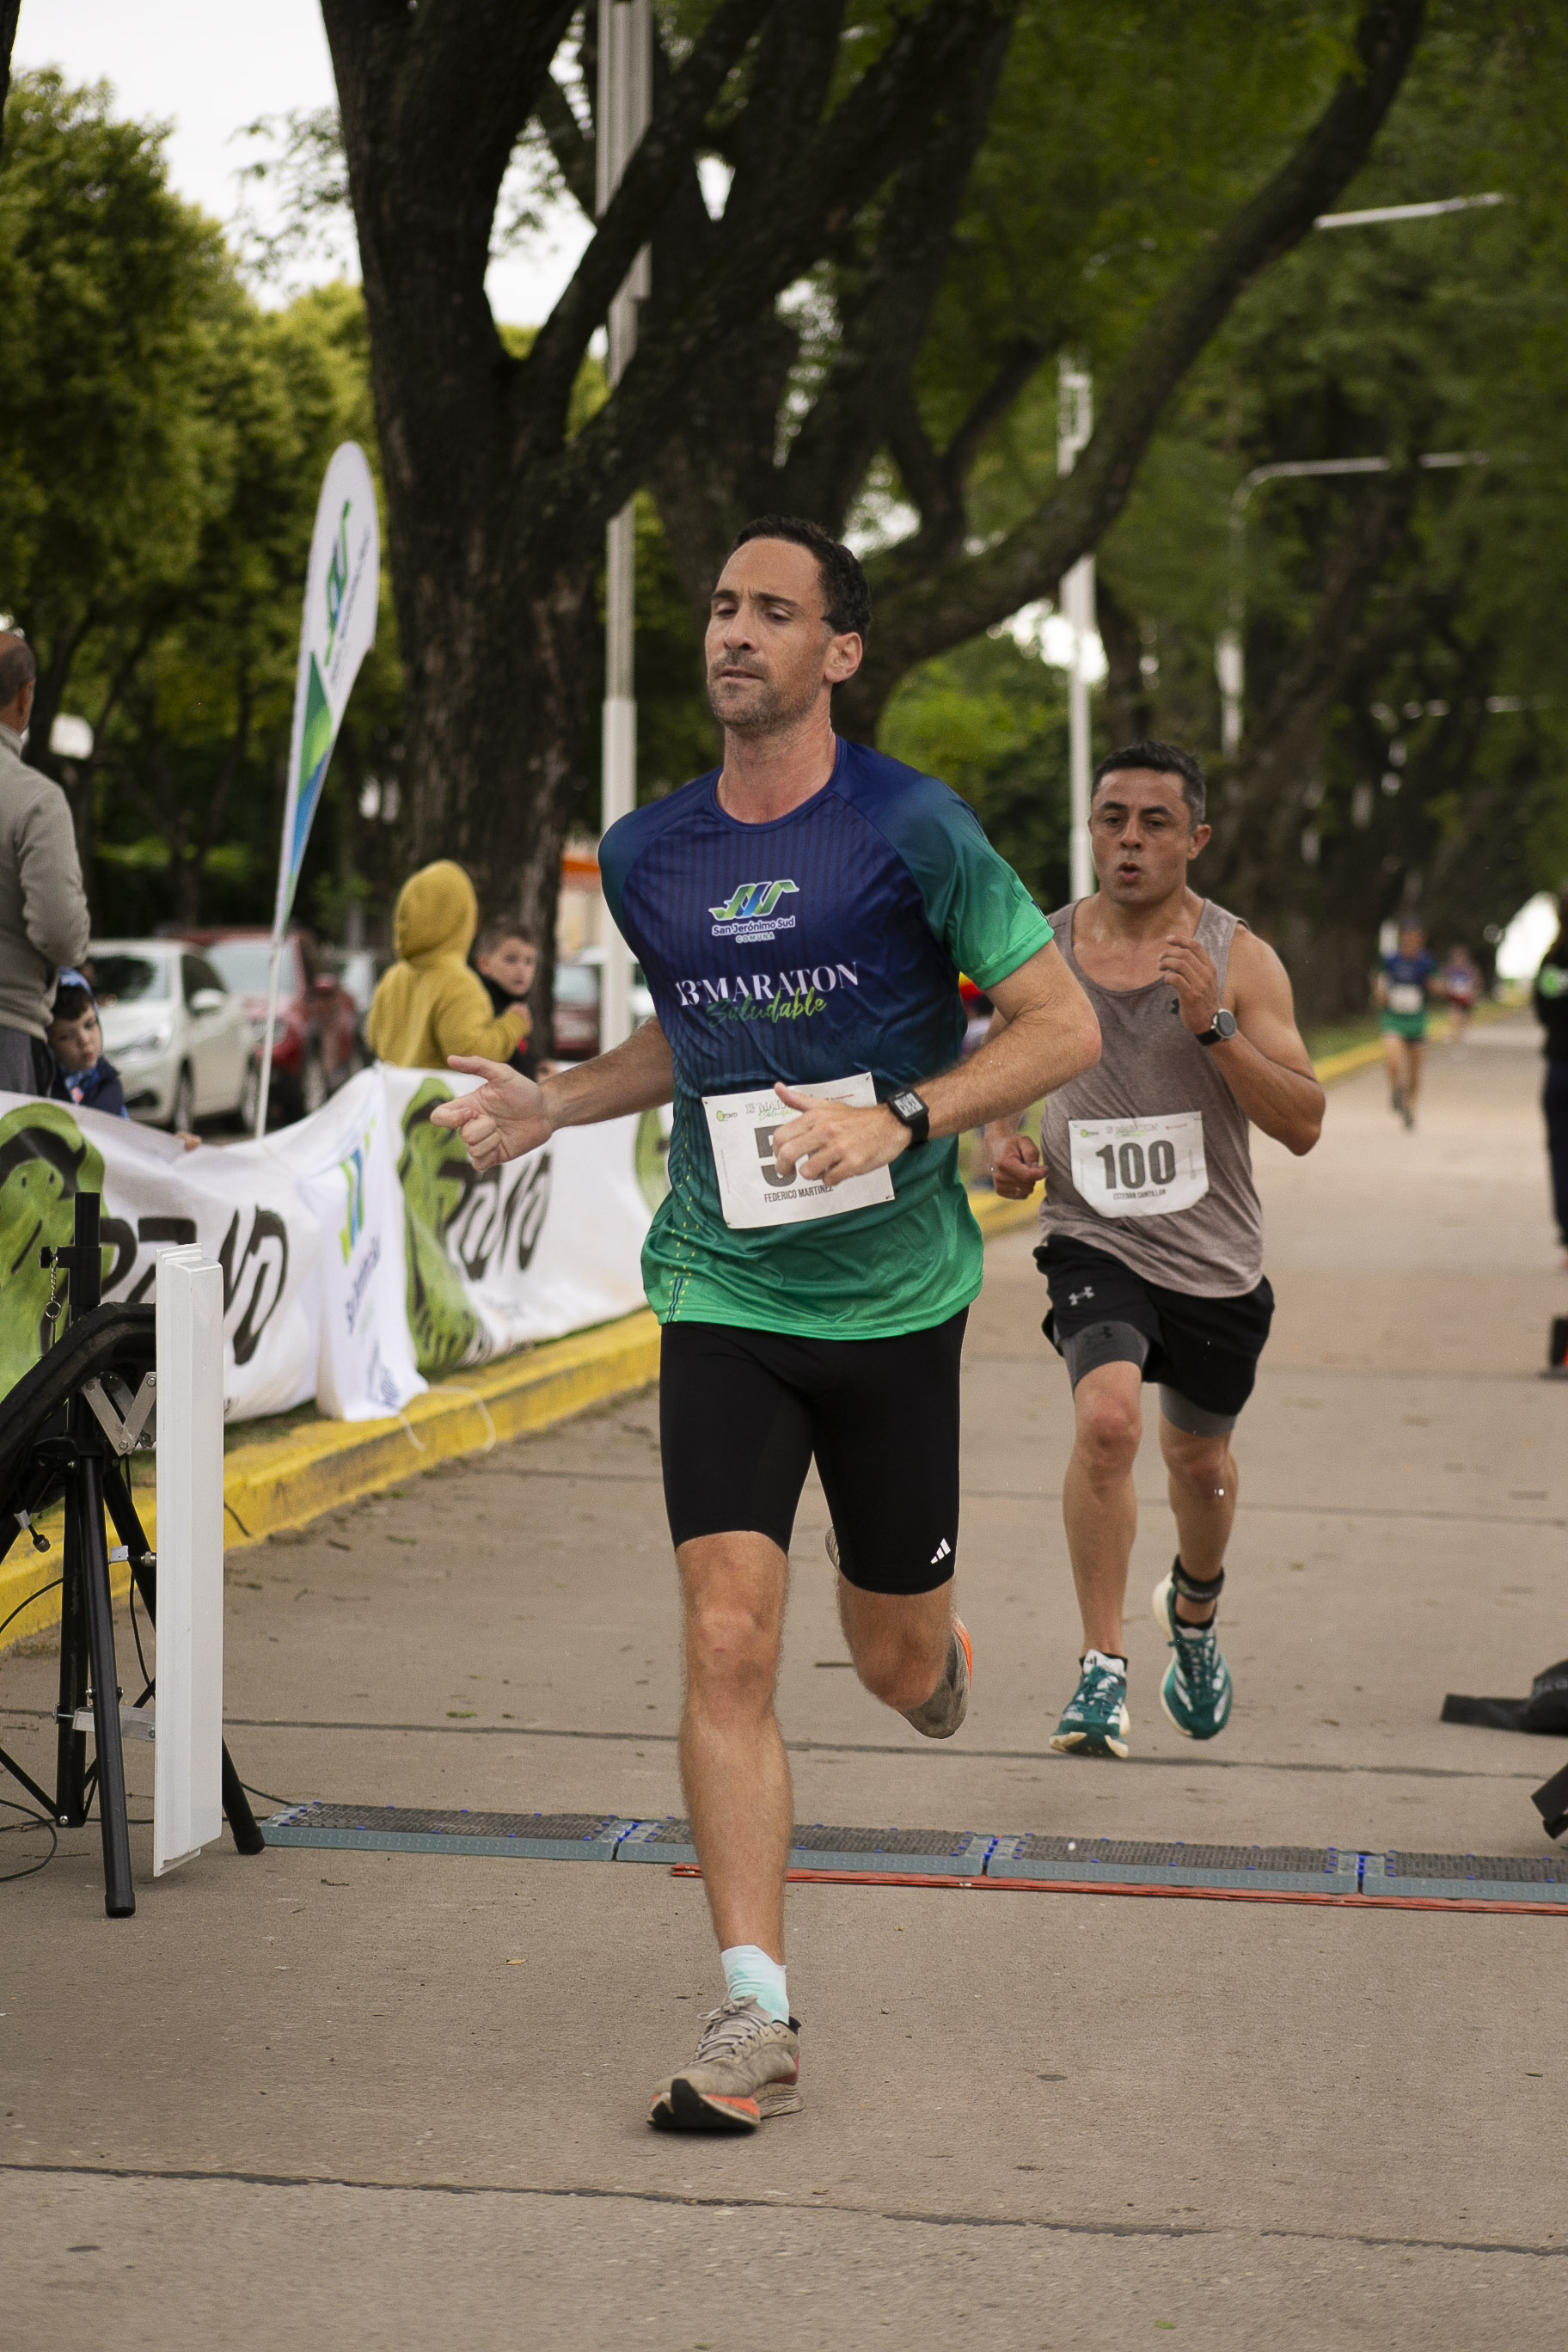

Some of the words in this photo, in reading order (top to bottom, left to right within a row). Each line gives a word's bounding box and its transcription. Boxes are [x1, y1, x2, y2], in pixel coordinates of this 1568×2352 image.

[713, 924, 732, 936] San
[732, 921, 776, 934] Jerónimo
[777, 916, 795, 929] Sud
[736, 932, 775, 943] COMUNA
[702, 961, 859, 1004] MARATON
[706, 986, 827, 1027] Saludable
[1095, 1140, 1176, 1190] 100
[764, 1190, 797, 1203] FEDERICO
